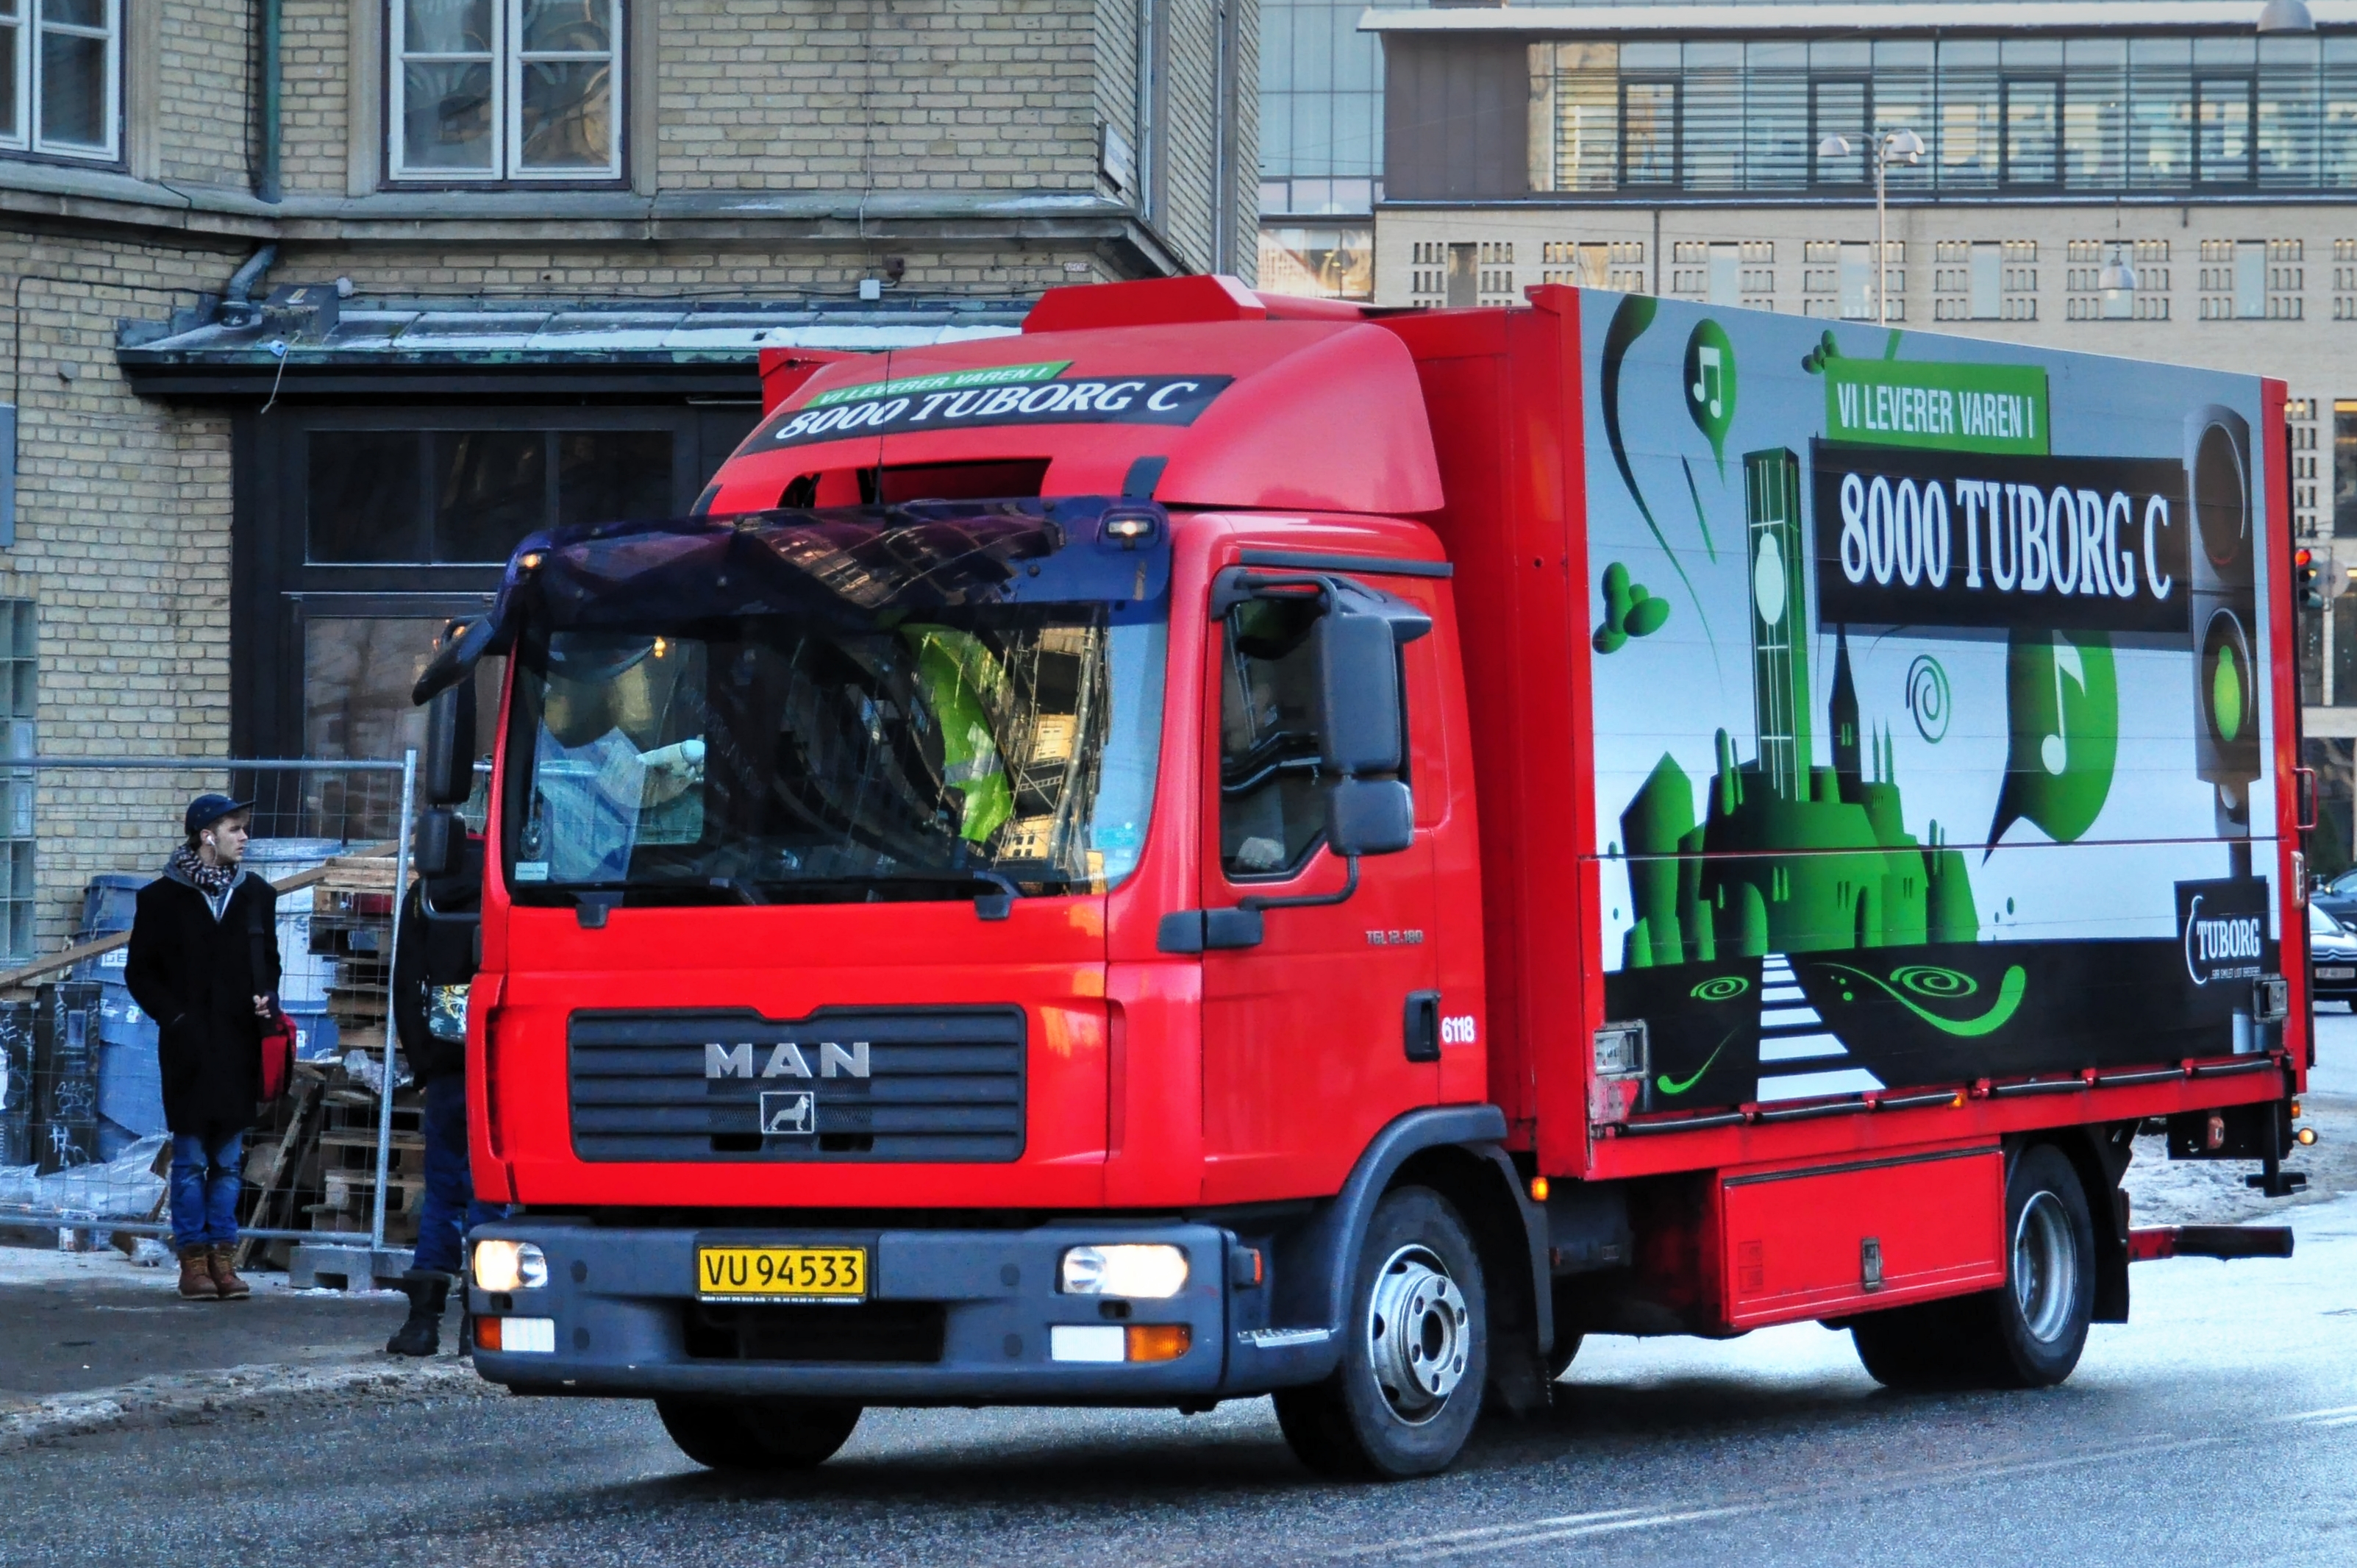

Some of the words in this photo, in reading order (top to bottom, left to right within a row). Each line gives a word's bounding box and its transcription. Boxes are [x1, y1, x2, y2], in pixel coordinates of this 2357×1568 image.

[819, 392, 843, 405] VI
[845, 376, 949, 399] LEVERER
[955, 368, 1033, 385] VAREN
[775, 393, 911, 440] 8000
[909, 381, 1147, 421] TUBORG
[1147, 382, 1199, 412] C
[1836, 382, 1858, 429] VI
[1864, 385, 1954, 435] LEVERER
[1958, 391, 2022, 438] VAREN
[1840, 472, 1949, 588] 8000
[1955, 478, 2136, 599] TUBORG
[2144, 494, 2172, 600] C
[2196, 917, 2261, 961] TUBORG
[1441, 1016, 1475, 1043] 6118
[705, 1042, 870, 1078] MAN
[705, 1255, 748, 1286] VU
